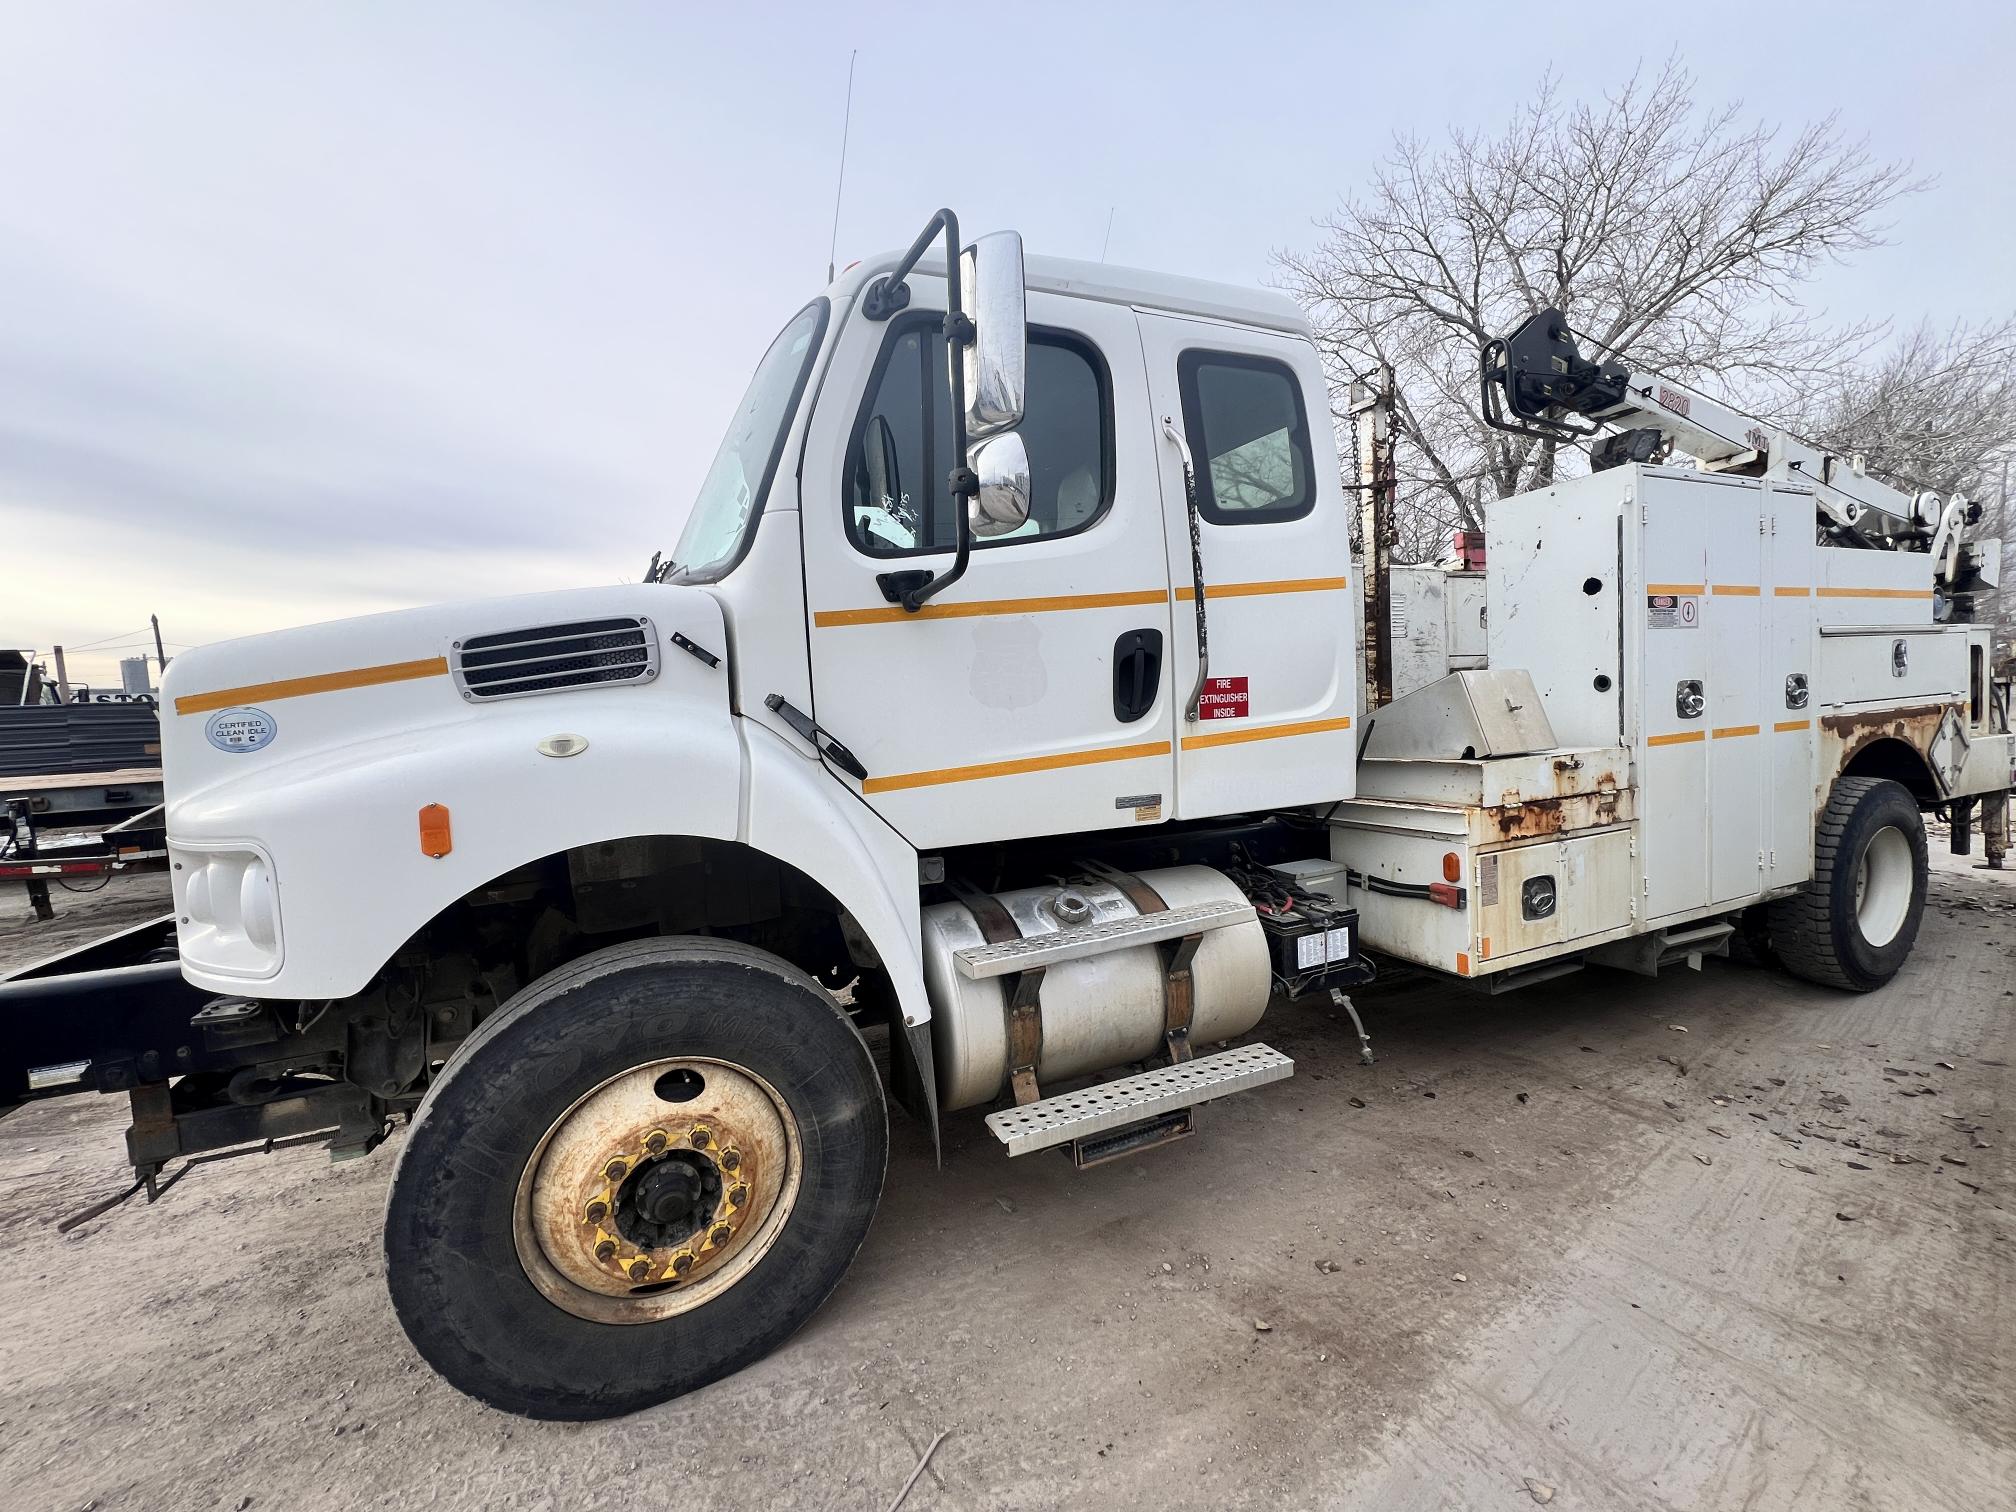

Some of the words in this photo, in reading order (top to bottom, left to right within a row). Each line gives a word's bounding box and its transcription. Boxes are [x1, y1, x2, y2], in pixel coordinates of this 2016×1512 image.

[1216, 679, 1231, 689] FIRE
[1199, 692, 1248, 704] EXTINGUISHER
[1213, 707, 1236, 718] INSIDE
[218, 720, 262, 730] CERTIFIED
[215, 729, 245, 737] CLEAN
[247, 727, 267, 735] IDLE
